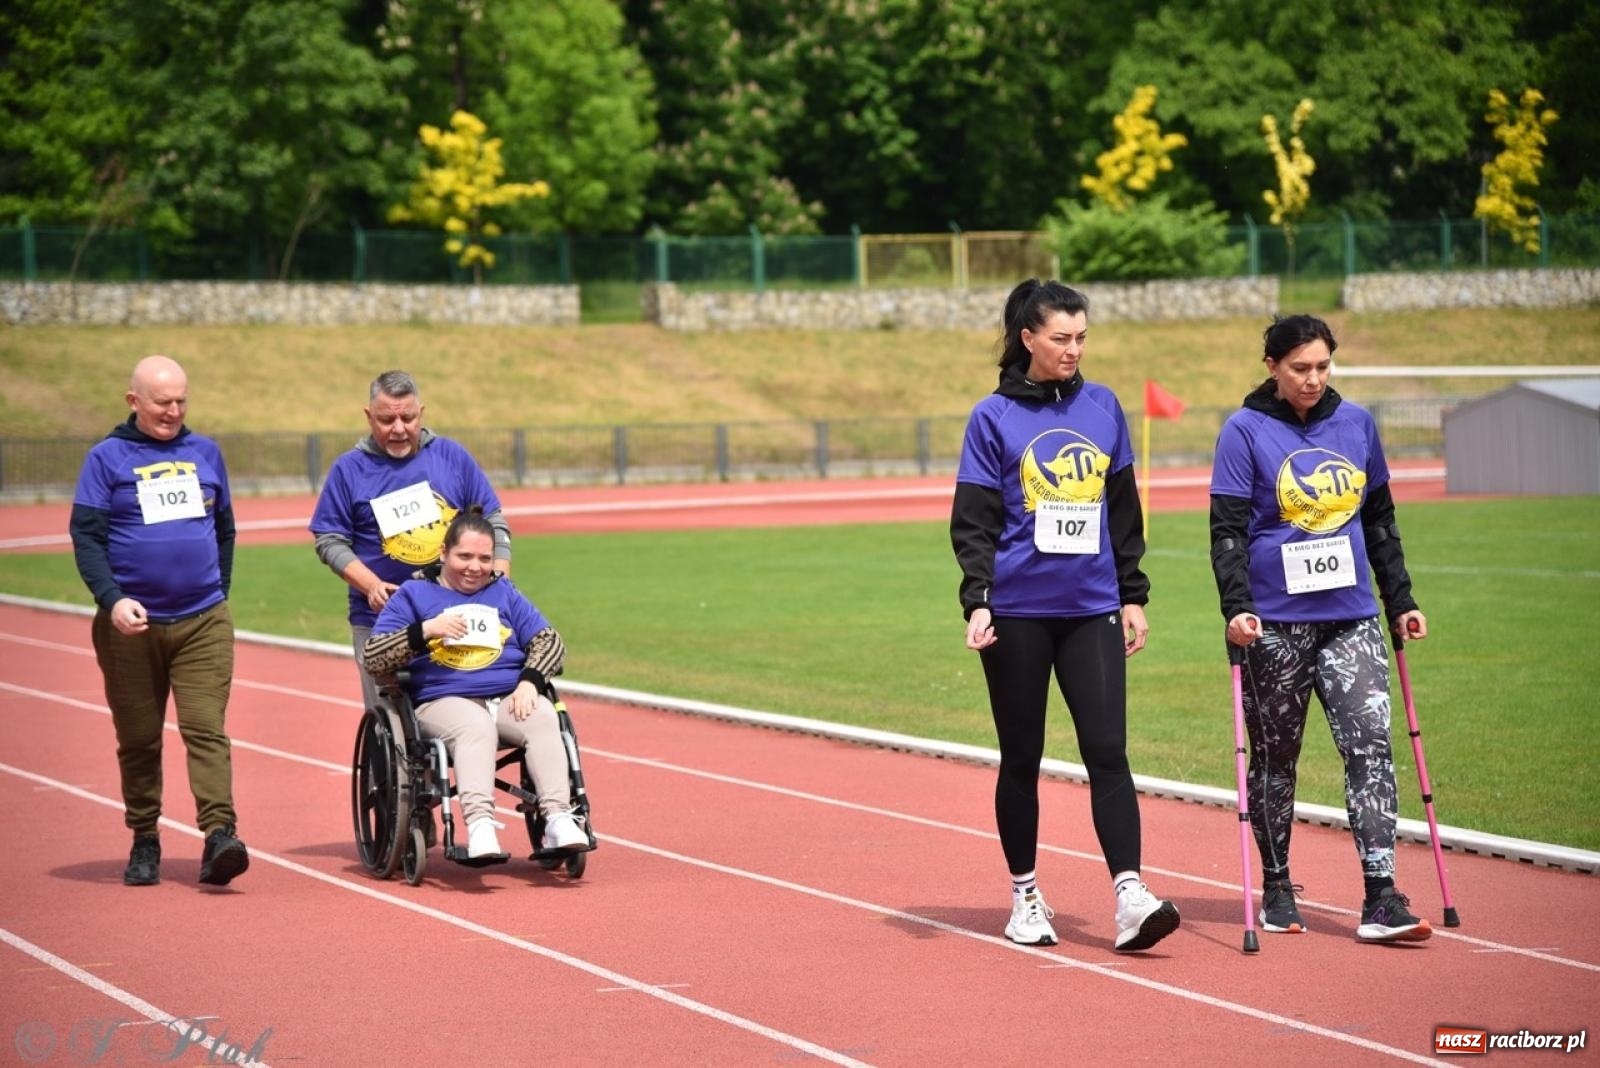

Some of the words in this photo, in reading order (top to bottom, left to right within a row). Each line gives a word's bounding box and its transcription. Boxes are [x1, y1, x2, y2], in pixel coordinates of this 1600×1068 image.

[158, 490, 188, 506] 102
[392, 501, 420, 519] 120
[1056, 519, 1087, 536] 107
[1304, 556, 1339, 574] 160
[470, 619, 487, 632] 16
